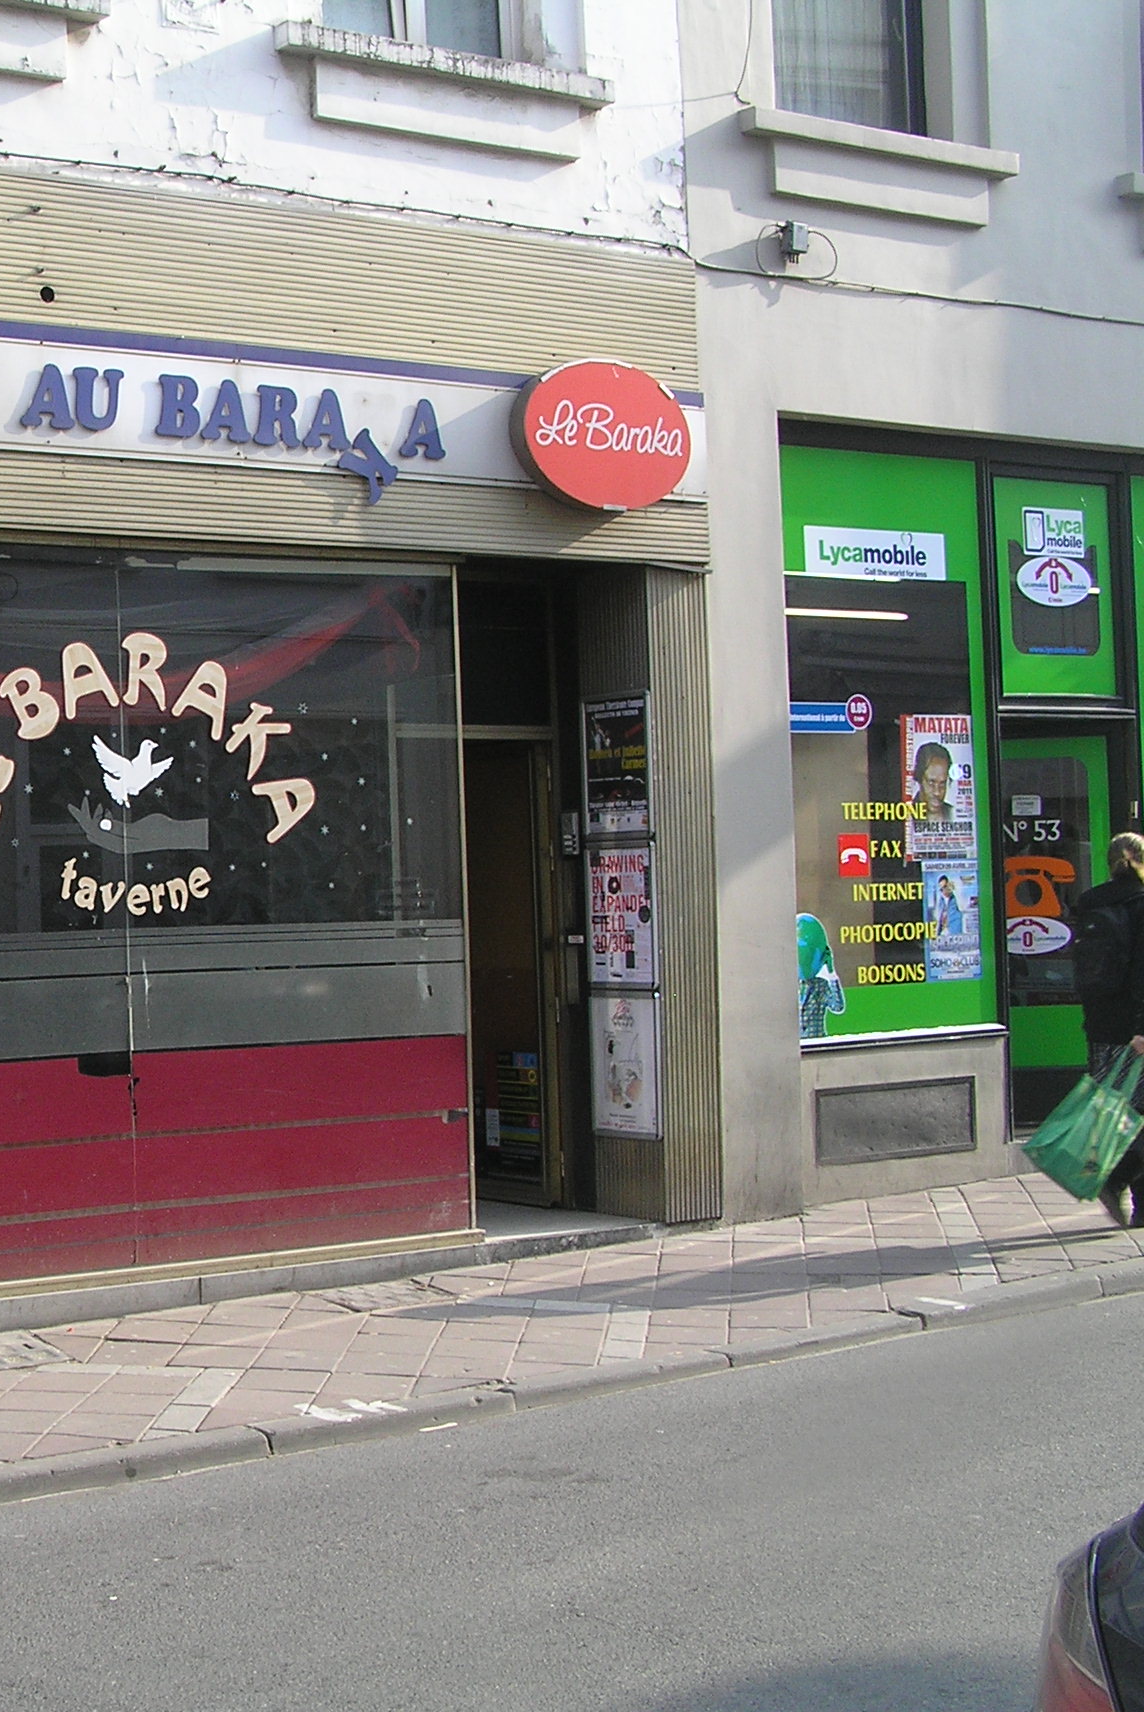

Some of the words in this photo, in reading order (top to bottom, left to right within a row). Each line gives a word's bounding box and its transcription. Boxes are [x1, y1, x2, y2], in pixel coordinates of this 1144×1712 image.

[19, 363, 124, 432] AU
[535, 399, 578, 446] Le
[576, 403, 683, 457] Baraka
[1046, 514, 1082, 537] Lyca
[818, 538, 927, 567] Lycamobile
[1046, 536, 1083, 549] mobile
[864, 567, 876, 576] Call
[877, 568, 887, 576] the
[888, 569, 905, 577] world
[915, 570, 928, 578] less
[913, 716, 969, 734] MATATA
[940, 733, 970, 745] FOREVER
[841, 802, 927, 821] TELEPHONE
[914, 820, 940, 834] ESPACE
[941, 819, 973, 833] SENGHOR
[1032, 819, 1062, 842] 53
[869, 840, 902, 859] FAX
[60, 857, 213, 917] taverne
[852, 882, 925, 902] INTERNET
[840, 922, 938, 944] PHOTOCOPIE
[857, 963, 926, 985] BOISONS
